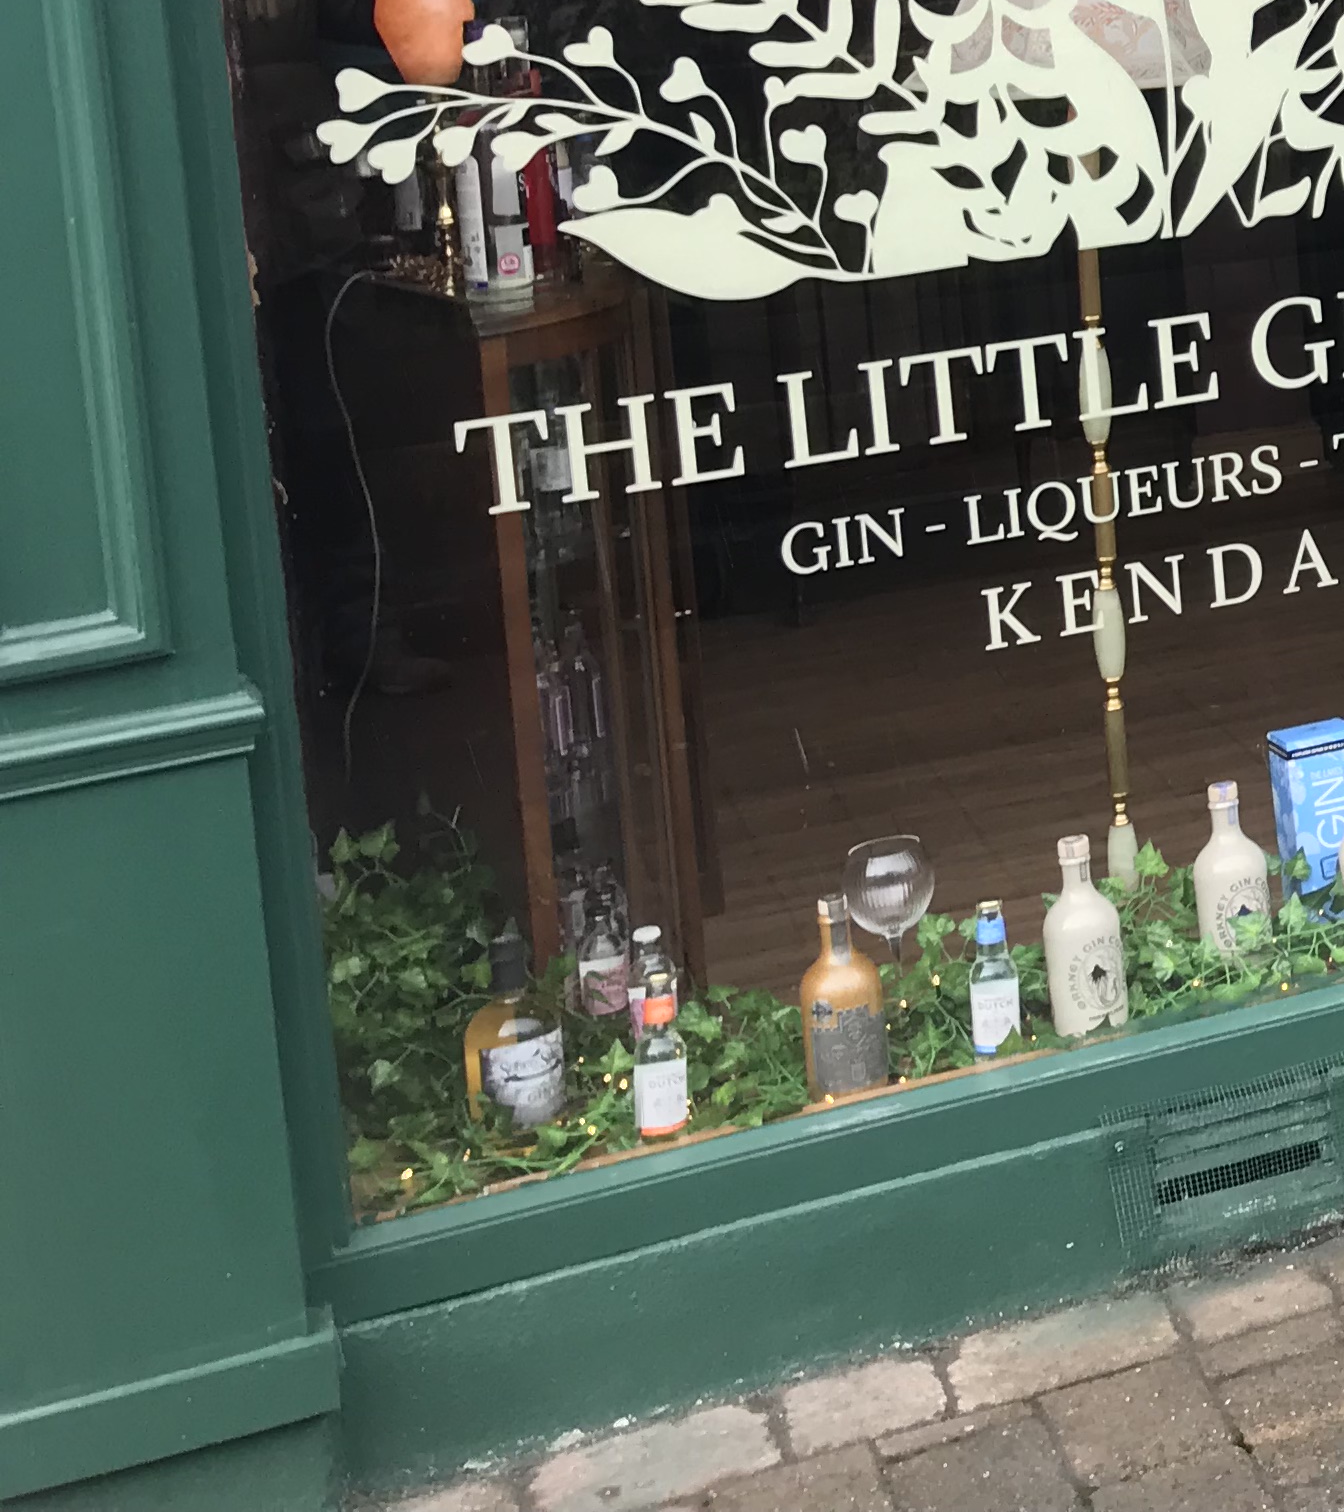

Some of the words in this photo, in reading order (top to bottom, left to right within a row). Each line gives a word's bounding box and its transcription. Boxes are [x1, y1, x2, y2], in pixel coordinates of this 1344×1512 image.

[453, 382, 746, 516] THE
[777, 311, 1220, 469] LITTLE
[780, 507, 905, 577] GIN
[964, 444, 1283, 548] LIQUEURS
